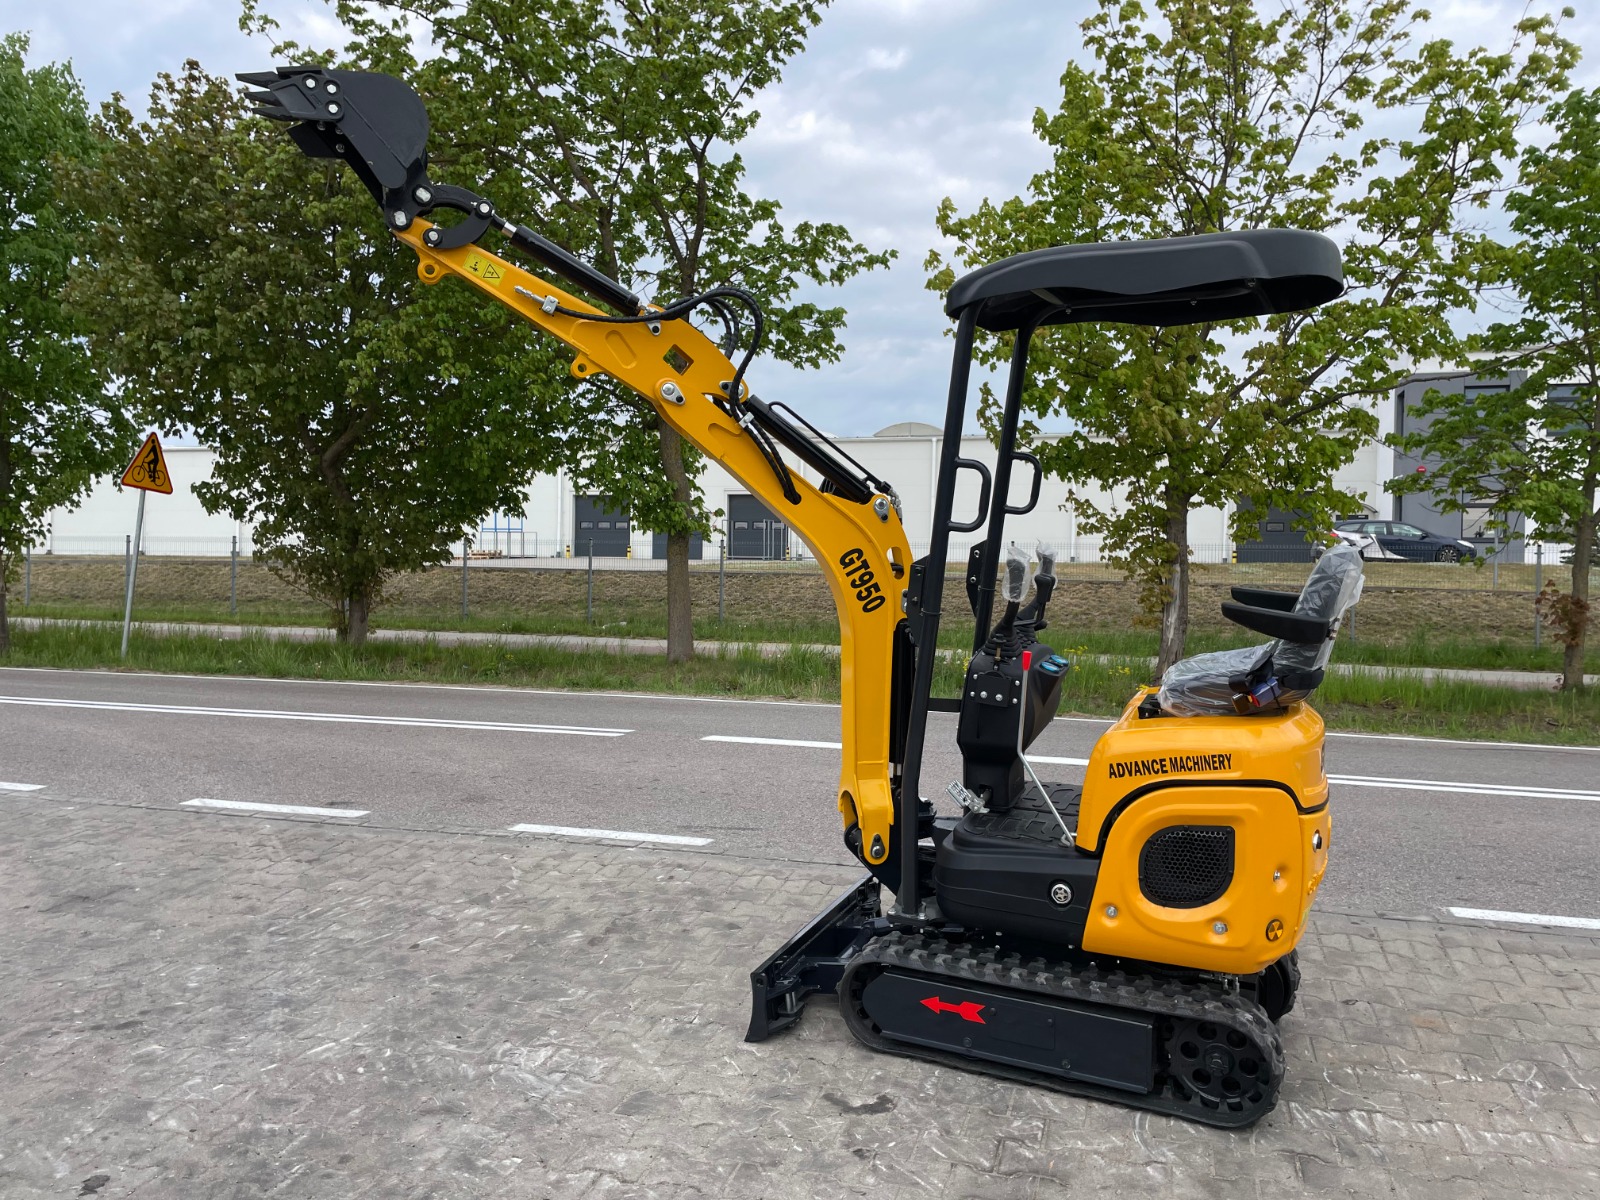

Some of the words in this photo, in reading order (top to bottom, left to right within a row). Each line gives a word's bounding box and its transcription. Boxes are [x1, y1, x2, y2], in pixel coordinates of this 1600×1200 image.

[839, 548, 886, 613] GT950
[1108, 758, 1168, 779] ADVANCE
[1169, 753, 1232, 773] MACHINERY
